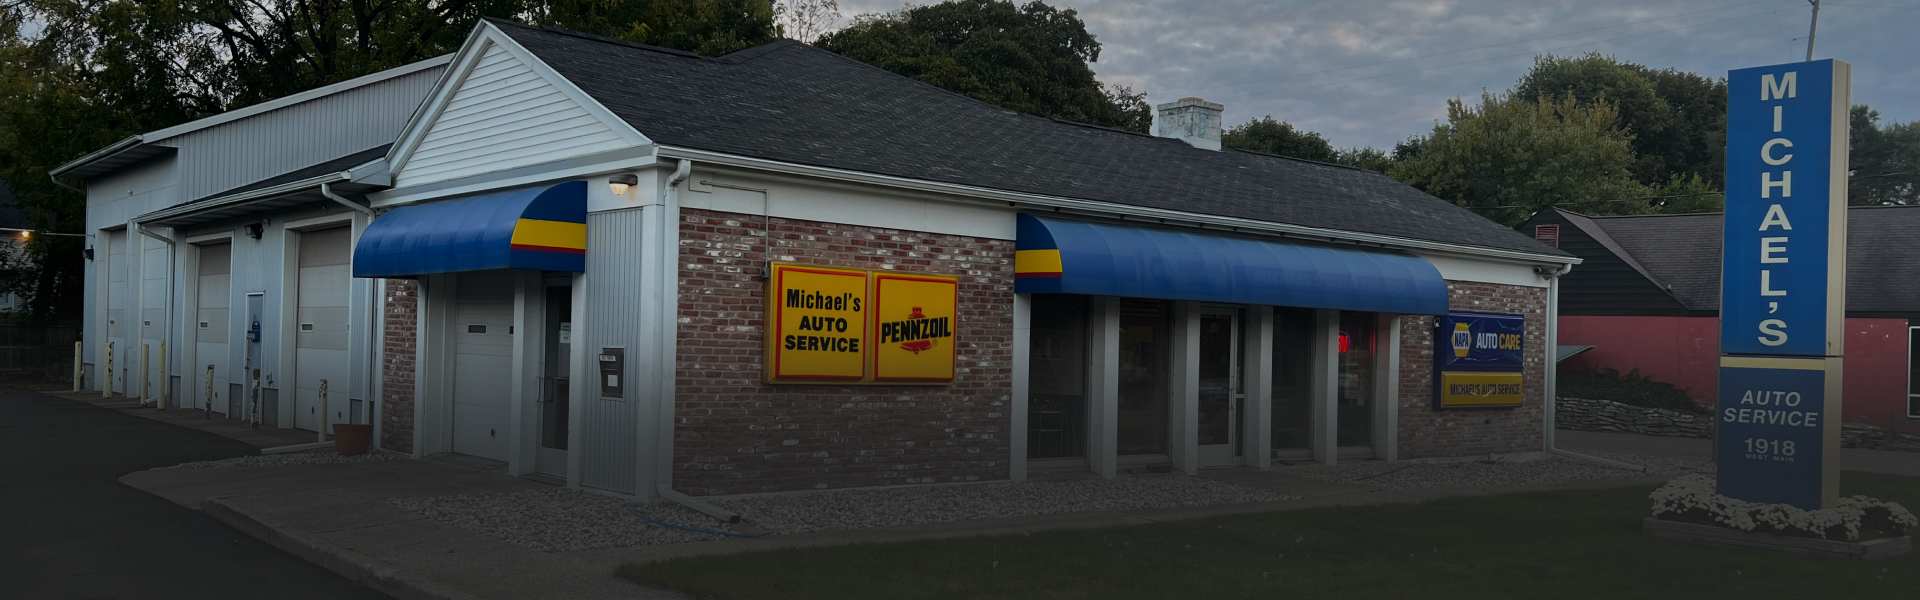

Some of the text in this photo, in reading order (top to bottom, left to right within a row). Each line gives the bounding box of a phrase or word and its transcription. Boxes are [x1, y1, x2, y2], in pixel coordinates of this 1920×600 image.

[1757, 71, 1797, 347] MICHAEL'S
[786, 288, 861, 312] Michael's
[799, 315, 848, 333] AUTO
[881, 317, 952, 344] PENNZOIL
[784, 335, 860, 353] SERVICE
[1454, 332, 1521, 350] NAPA AUTO CARE
[1450, 383, 1520, 395] MICHAEL'S AUTO SERVICE
[1740, 390, 1801, 407] AUTO
[1723, 407, 1819, 427] SERVICE
[1744, 438, 1796, 456] 1918
